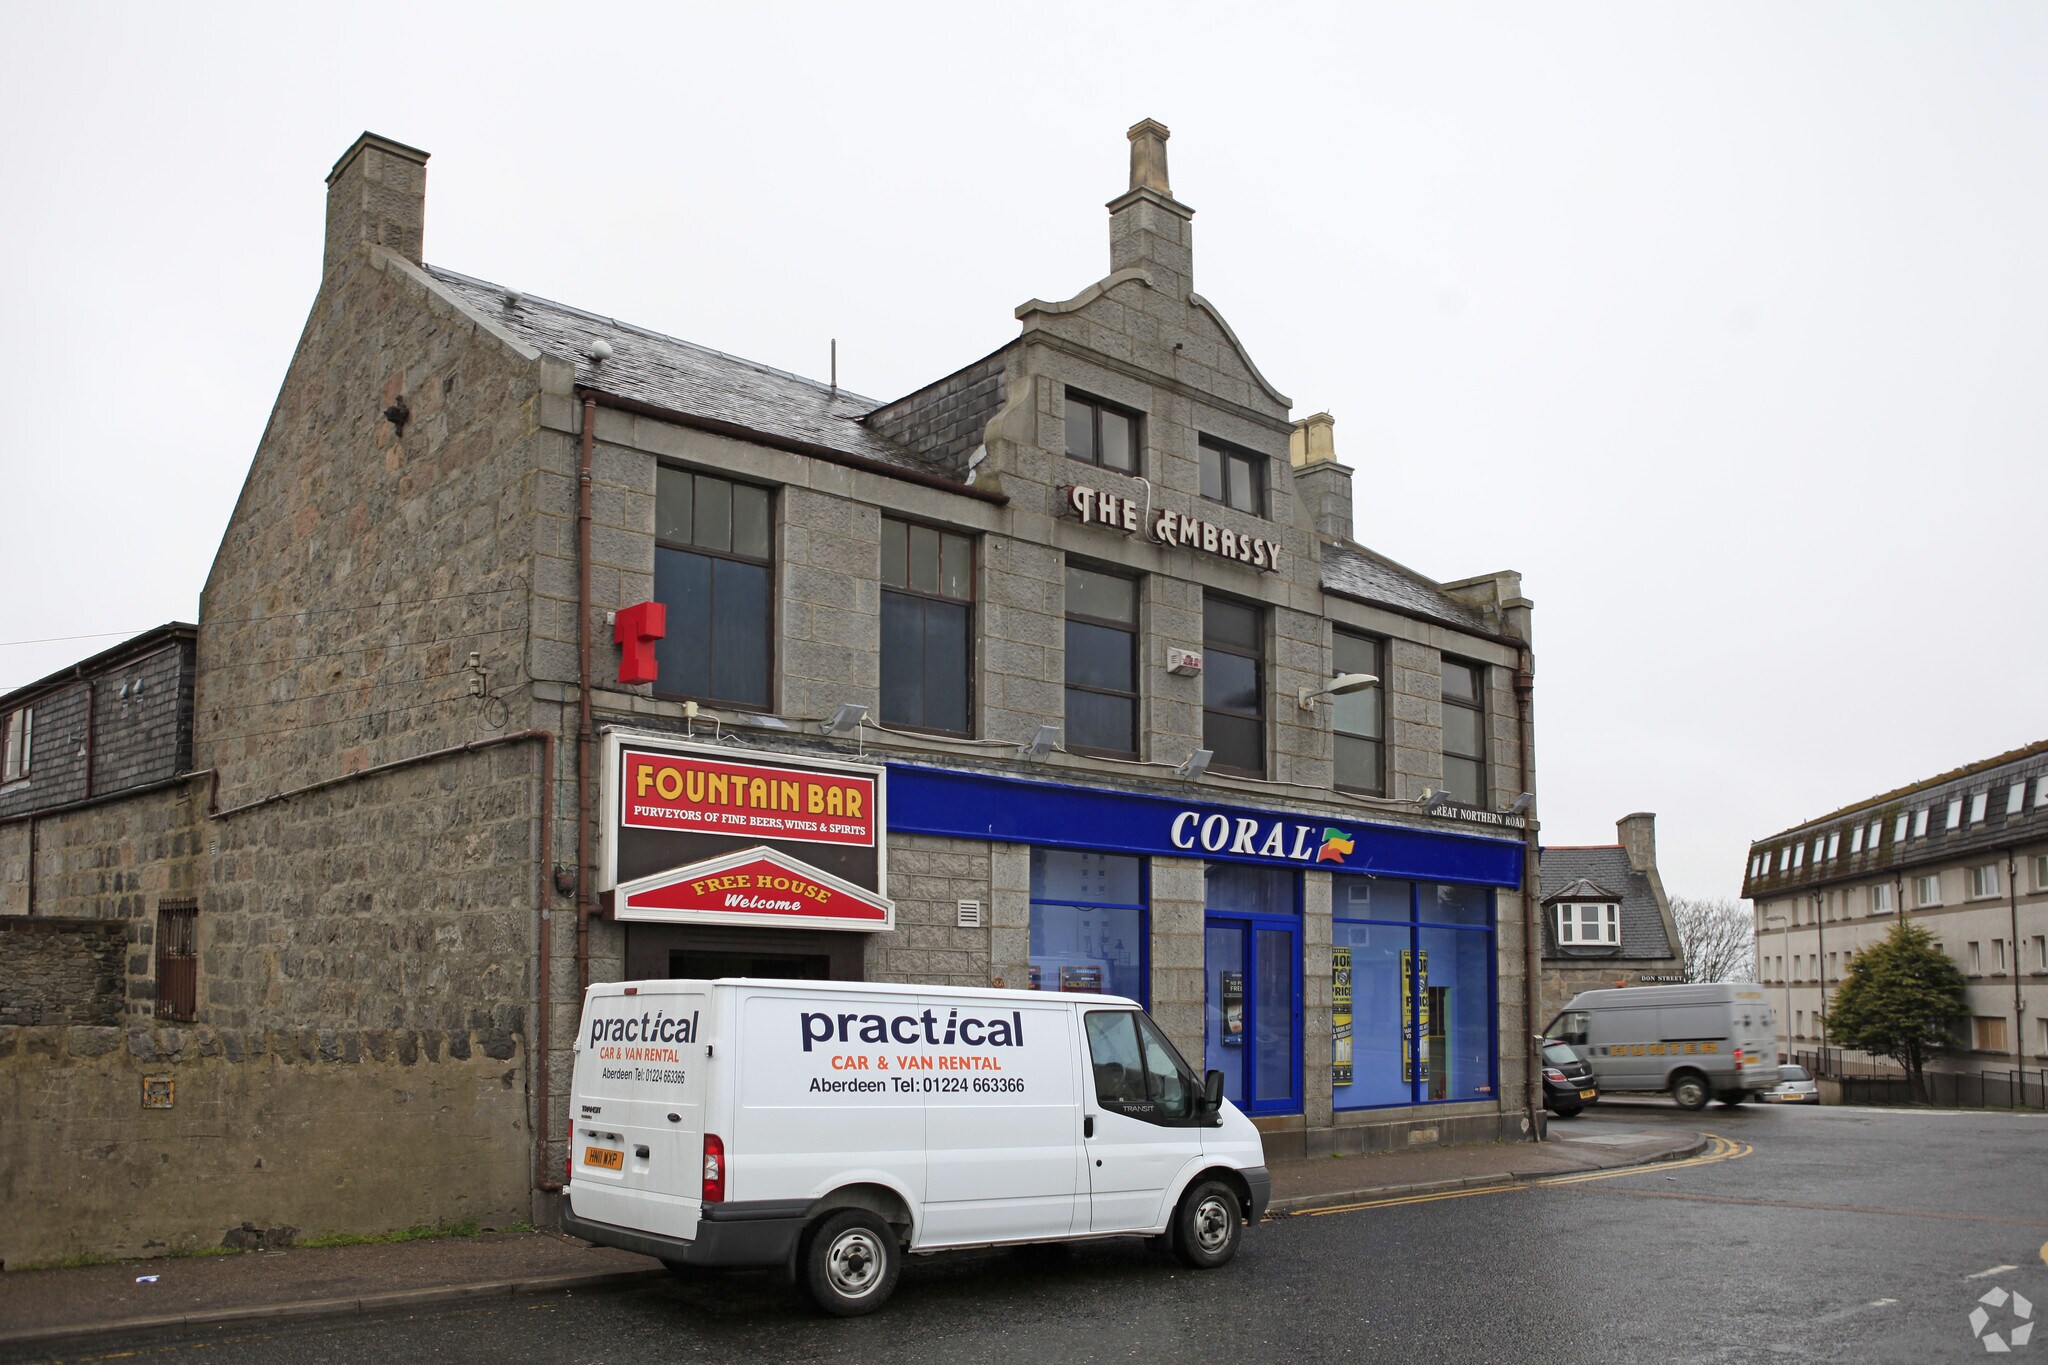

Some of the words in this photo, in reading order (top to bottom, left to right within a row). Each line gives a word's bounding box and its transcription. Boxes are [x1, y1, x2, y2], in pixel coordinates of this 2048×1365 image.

[1071, 485, 1137, 531] THE
[1155, 509, 1281, 570] EMBASSY
[636, 764, 800, 813] FOUNTAIN
[807, 783, 863, 818] BAR
[633, 805, 702, 821] PURVEYORS
[704, 812, 719, 823] OF
[721, 813, 747, 825] FINE
[819, 822, 827, 832] &
[829, 823, 866, 836] SPIRITS
[1460, 809, 1503, 825] NORTHERN
[1505, 815, 1525, 828] ROAD
[1171, 811, 1312, 860] CORAL
[691, 875, 751, 896] FREE
[756, 875, 832, 904] HOUSE
[724, 893, 802, 911] Welcome
[590, 1009, 700, 1049] practical
[800, 1007, 1024, 1052] practical
[600, 1046, 615, 1060] CAR
[616, 1047, 622, 1060] &
[625, 1047, 643, 1061] VAN
[644, 1048, 680, 1063] RENTAL
[1610, 1041, 1718, 1057] HUNTER
[831, 1055, 869, 1070] CAR
[877, 1055, 889, 1070] &
[896, 1055, 933, 1070] VAN
[938, 1056, 1002, 1071] RENTAL
[602, 1067, 633, 1080] Aberdeen
[645, 1068, 662, 1082] 01224
[663, 1069, 686, 1084] 663366
[809, 1077, 886, 1093] Aberdeen
[923, 1077, 969, 1093] 01224
[973, 1077, 1025, 1093] 663366
